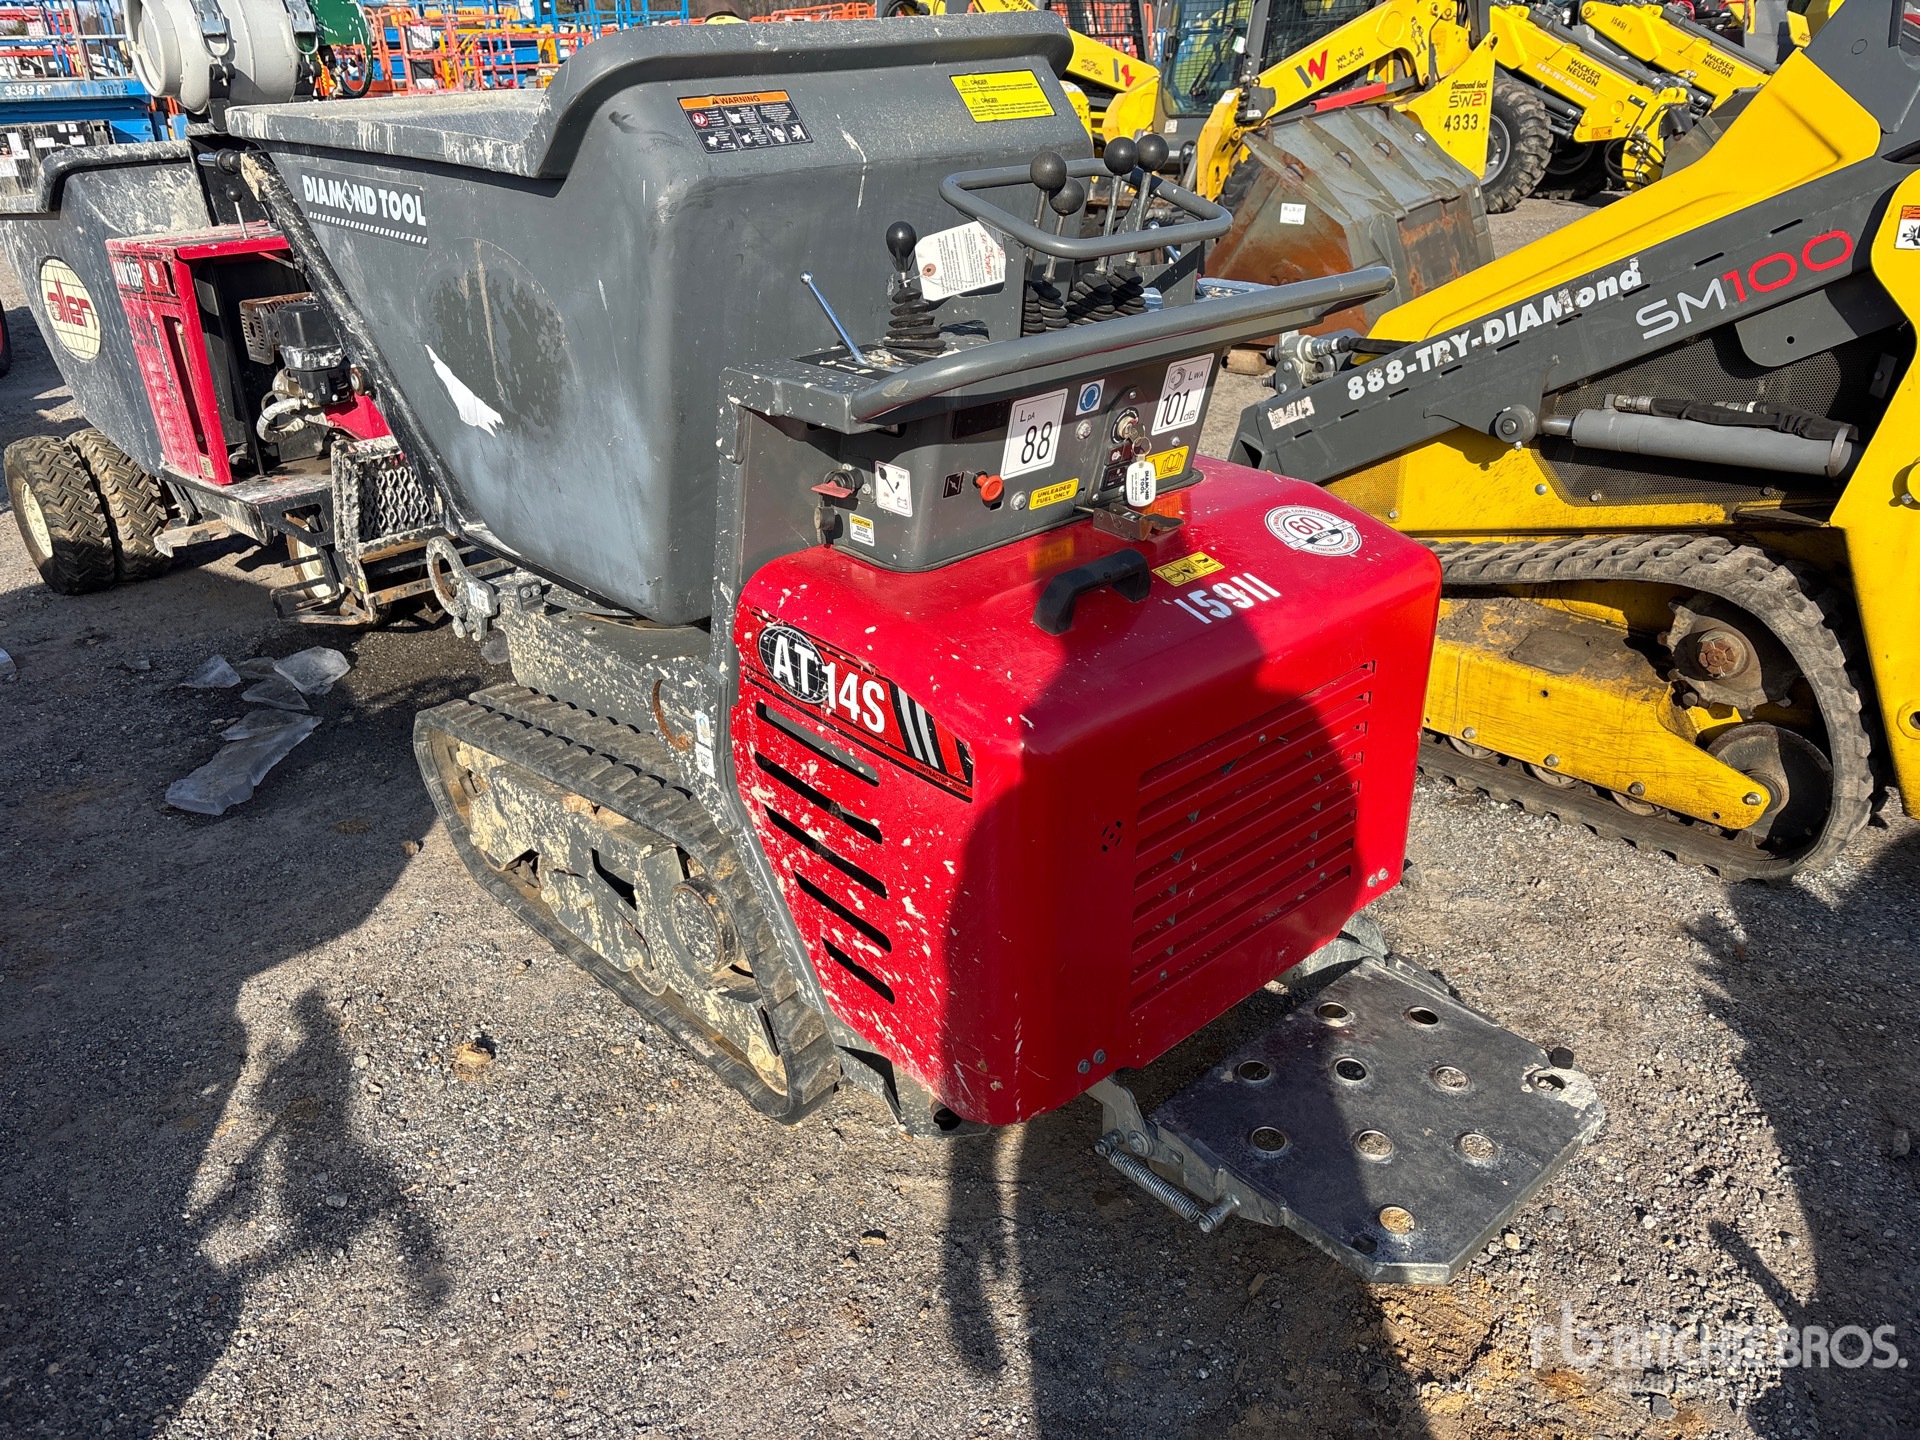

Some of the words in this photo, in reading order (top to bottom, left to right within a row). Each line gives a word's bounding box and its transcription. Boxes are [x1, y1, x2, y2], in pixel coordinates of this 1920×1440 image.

[1571, 57, 1602, 80] WACKER
[1701, 58, 1733, 78] NEUSON
[1706, 51, 1736, 71] WACKER
[1565, 64, 1599, 87] NEUSON
[720, 95, 761, 105] WARNING
[1448, 92, 1487, 109] SW21
[1444, 113, 1478, 132] 4333
[301, 174, 377, 215] DIAMOND
[378, 188, 427, 227] TOOL
[1635, 229, 1854, 340] SM100
[1347, 256, 1644, 401] 888-TRY-DIAMond
[1161, 388, 1190, 428] 101
[1021, 421, 1053, 464] 88
[1036, 496, 1052, 505] FUEL
[1053, 490, 1071, 500] ONLY
[1037, 484, 1072, 498] UNLEADED
[1288, 516, 1325, 536] 60
[1174, 572, 1282, 625] 15911
[915, 763, 949, 783] CONTRACTOR
